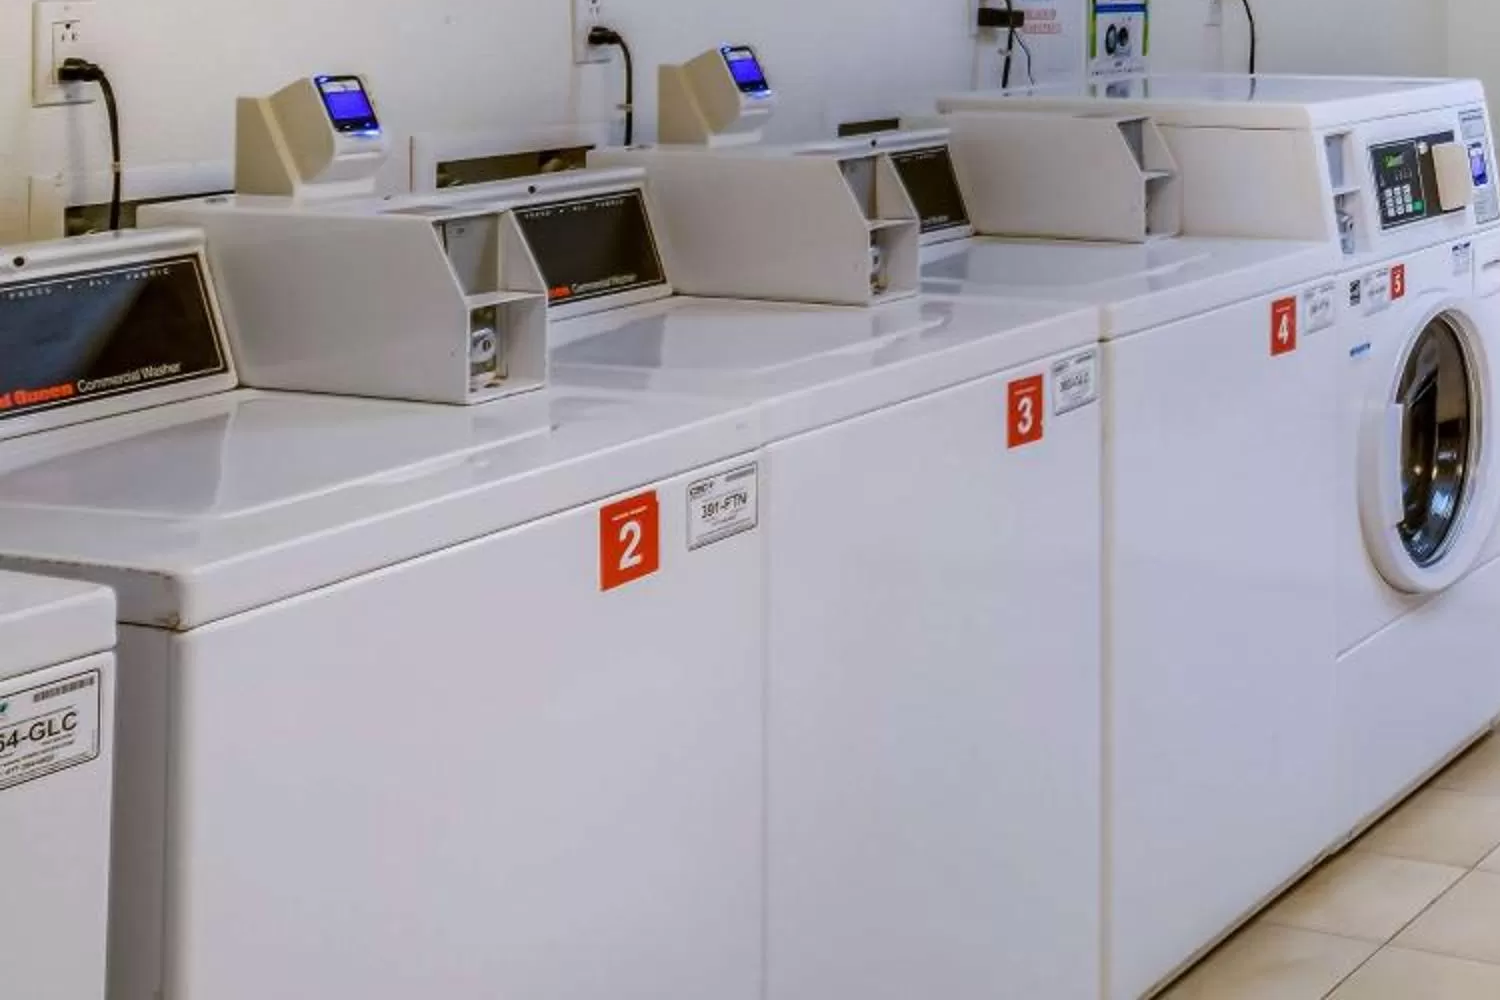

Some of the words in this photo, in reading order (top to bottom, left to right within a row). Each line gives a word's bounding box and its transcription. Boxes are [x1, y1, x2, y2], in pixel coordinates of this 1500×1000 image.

[1394, 273, 1401, 293] 5
[1278, 313, 1289, 345] 4
[77, 368, 141, 393] Commercial
[141, 361, 181, 380] Washer
[1017, 396, 1033, 435] 3
[619, 519, 643, 571] 2
